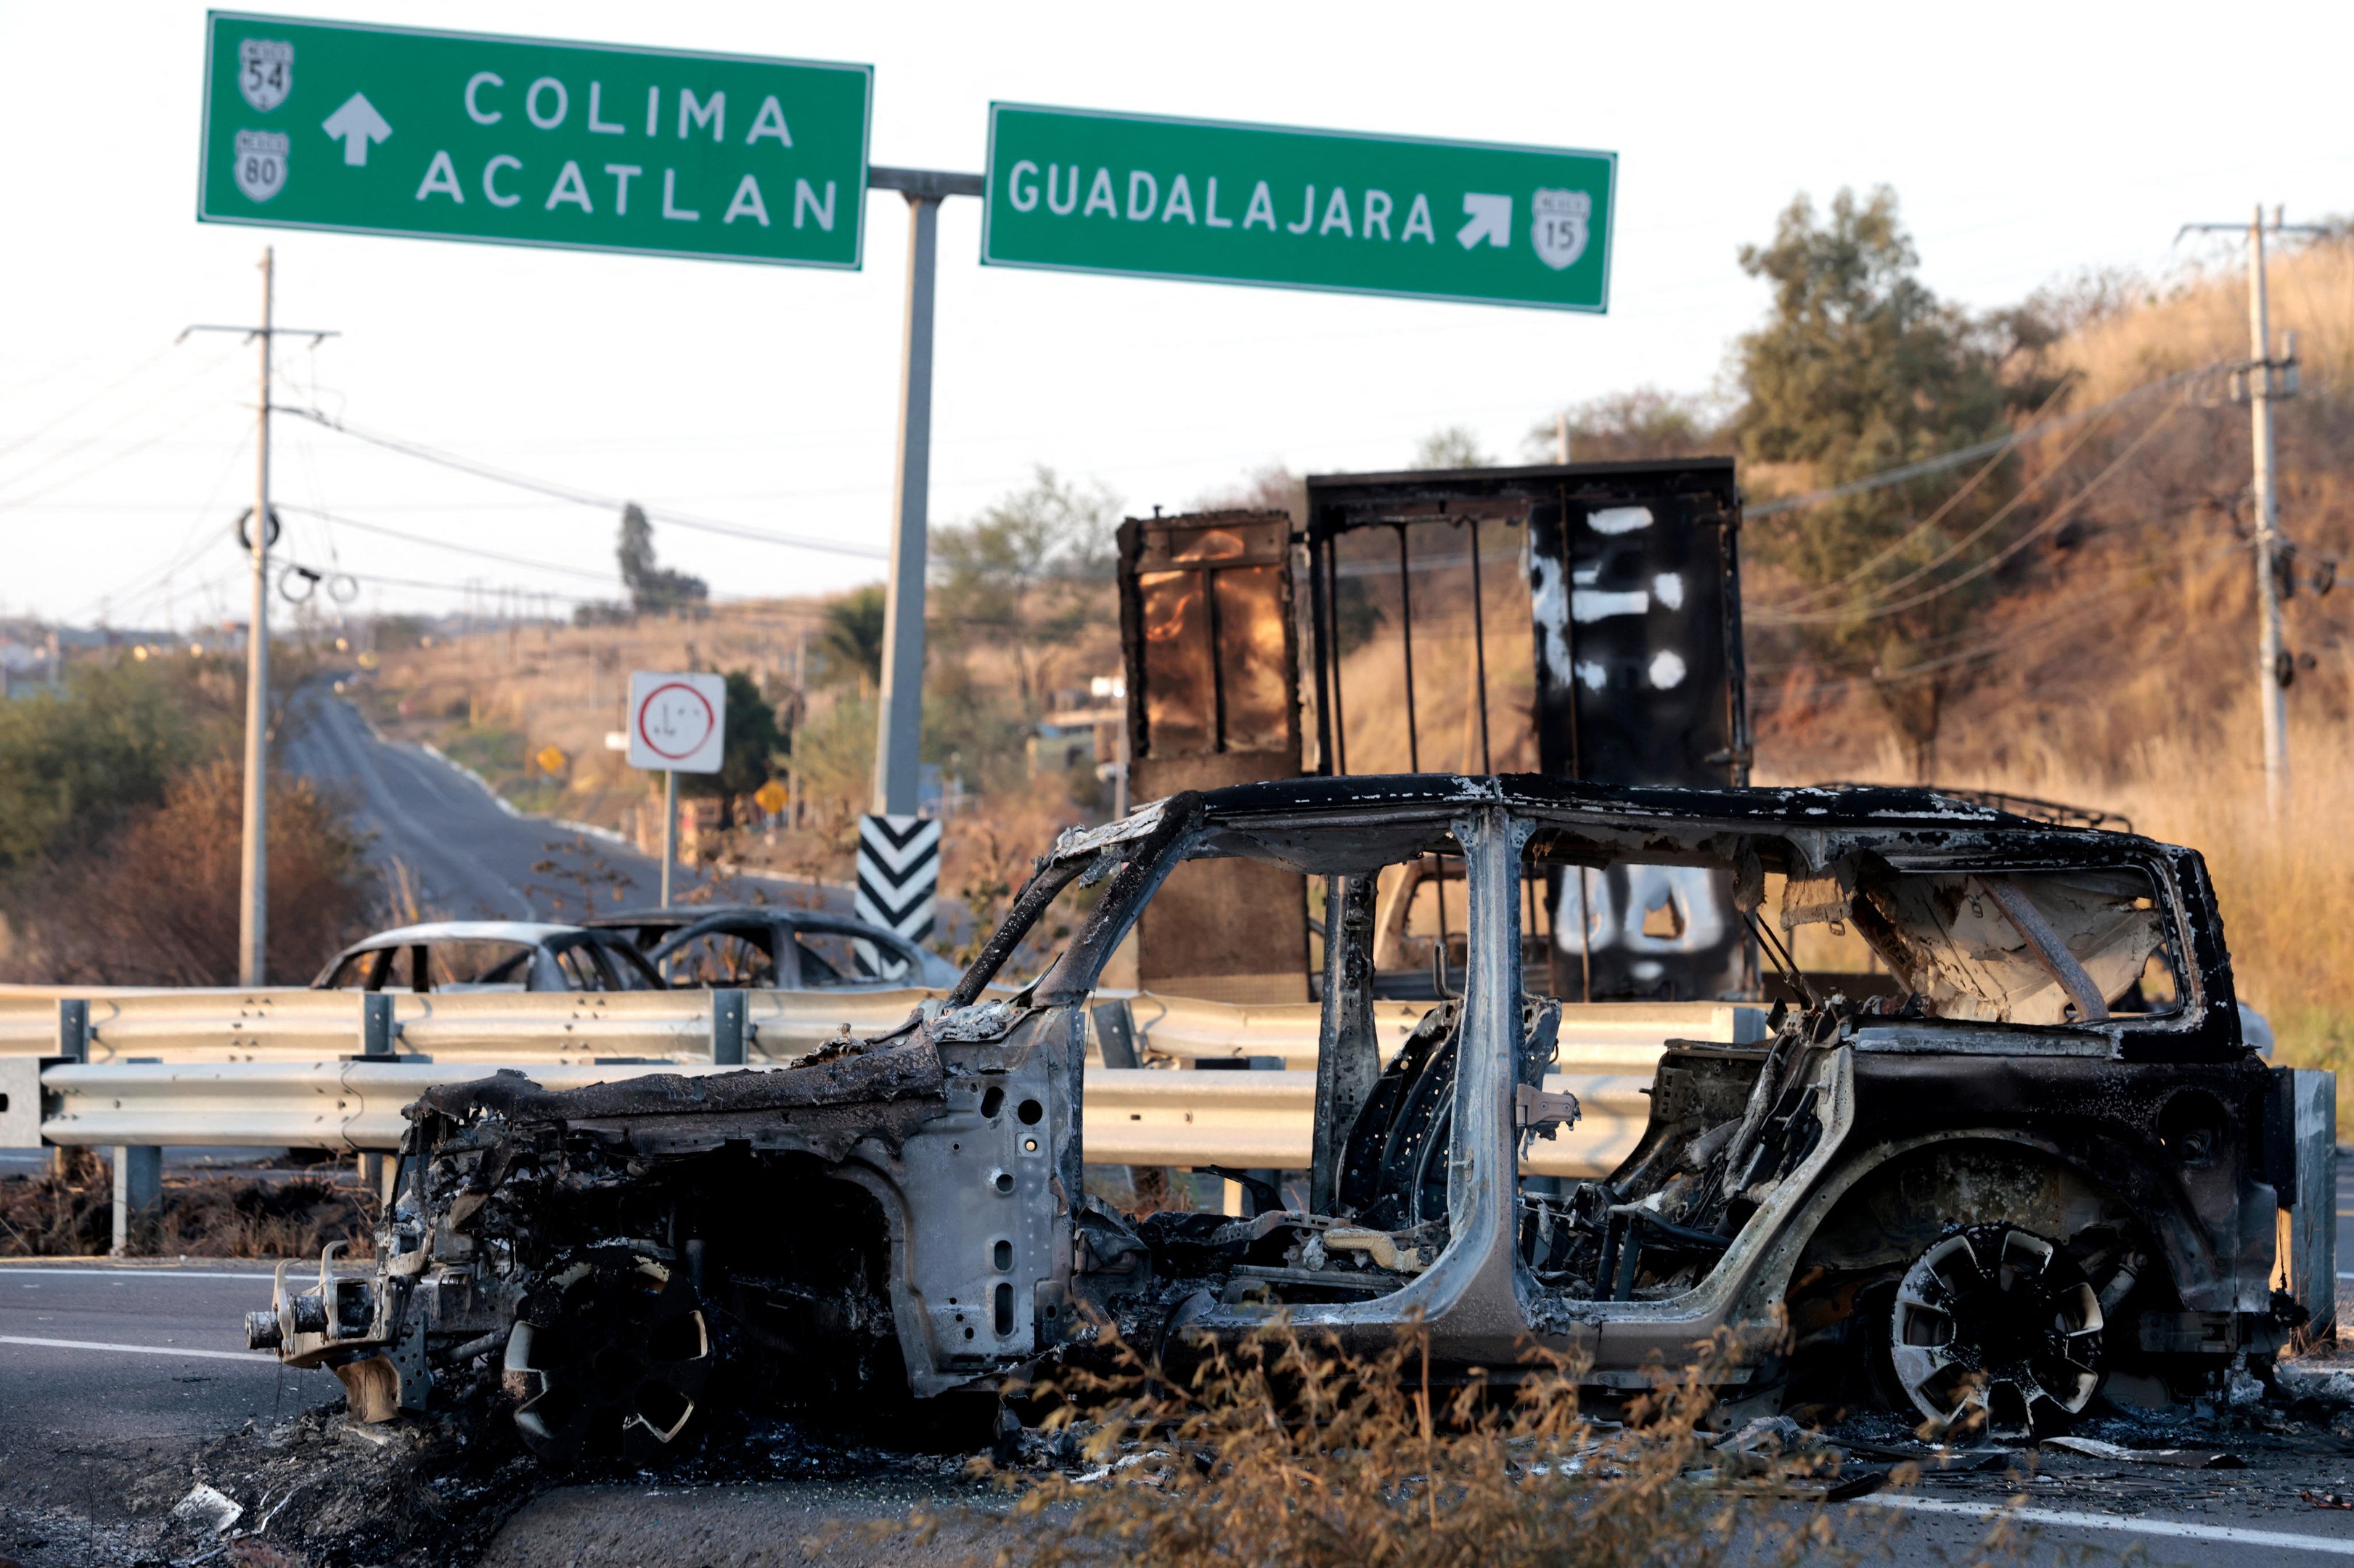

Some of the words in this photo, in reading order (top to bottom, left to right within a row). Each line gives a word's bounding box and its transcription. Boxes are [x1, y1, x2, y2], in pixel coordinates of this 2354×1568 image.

[248, 58, 284, 91] 54
[465, 72, 793, 147] COLIMA
[245, 157, 277, 185] 80
[416, 150, 835, 231] ACATLAN
[1009, 160, 1435, 244] GUADALAJARA
[1546, 220, 1575, 250] 15
